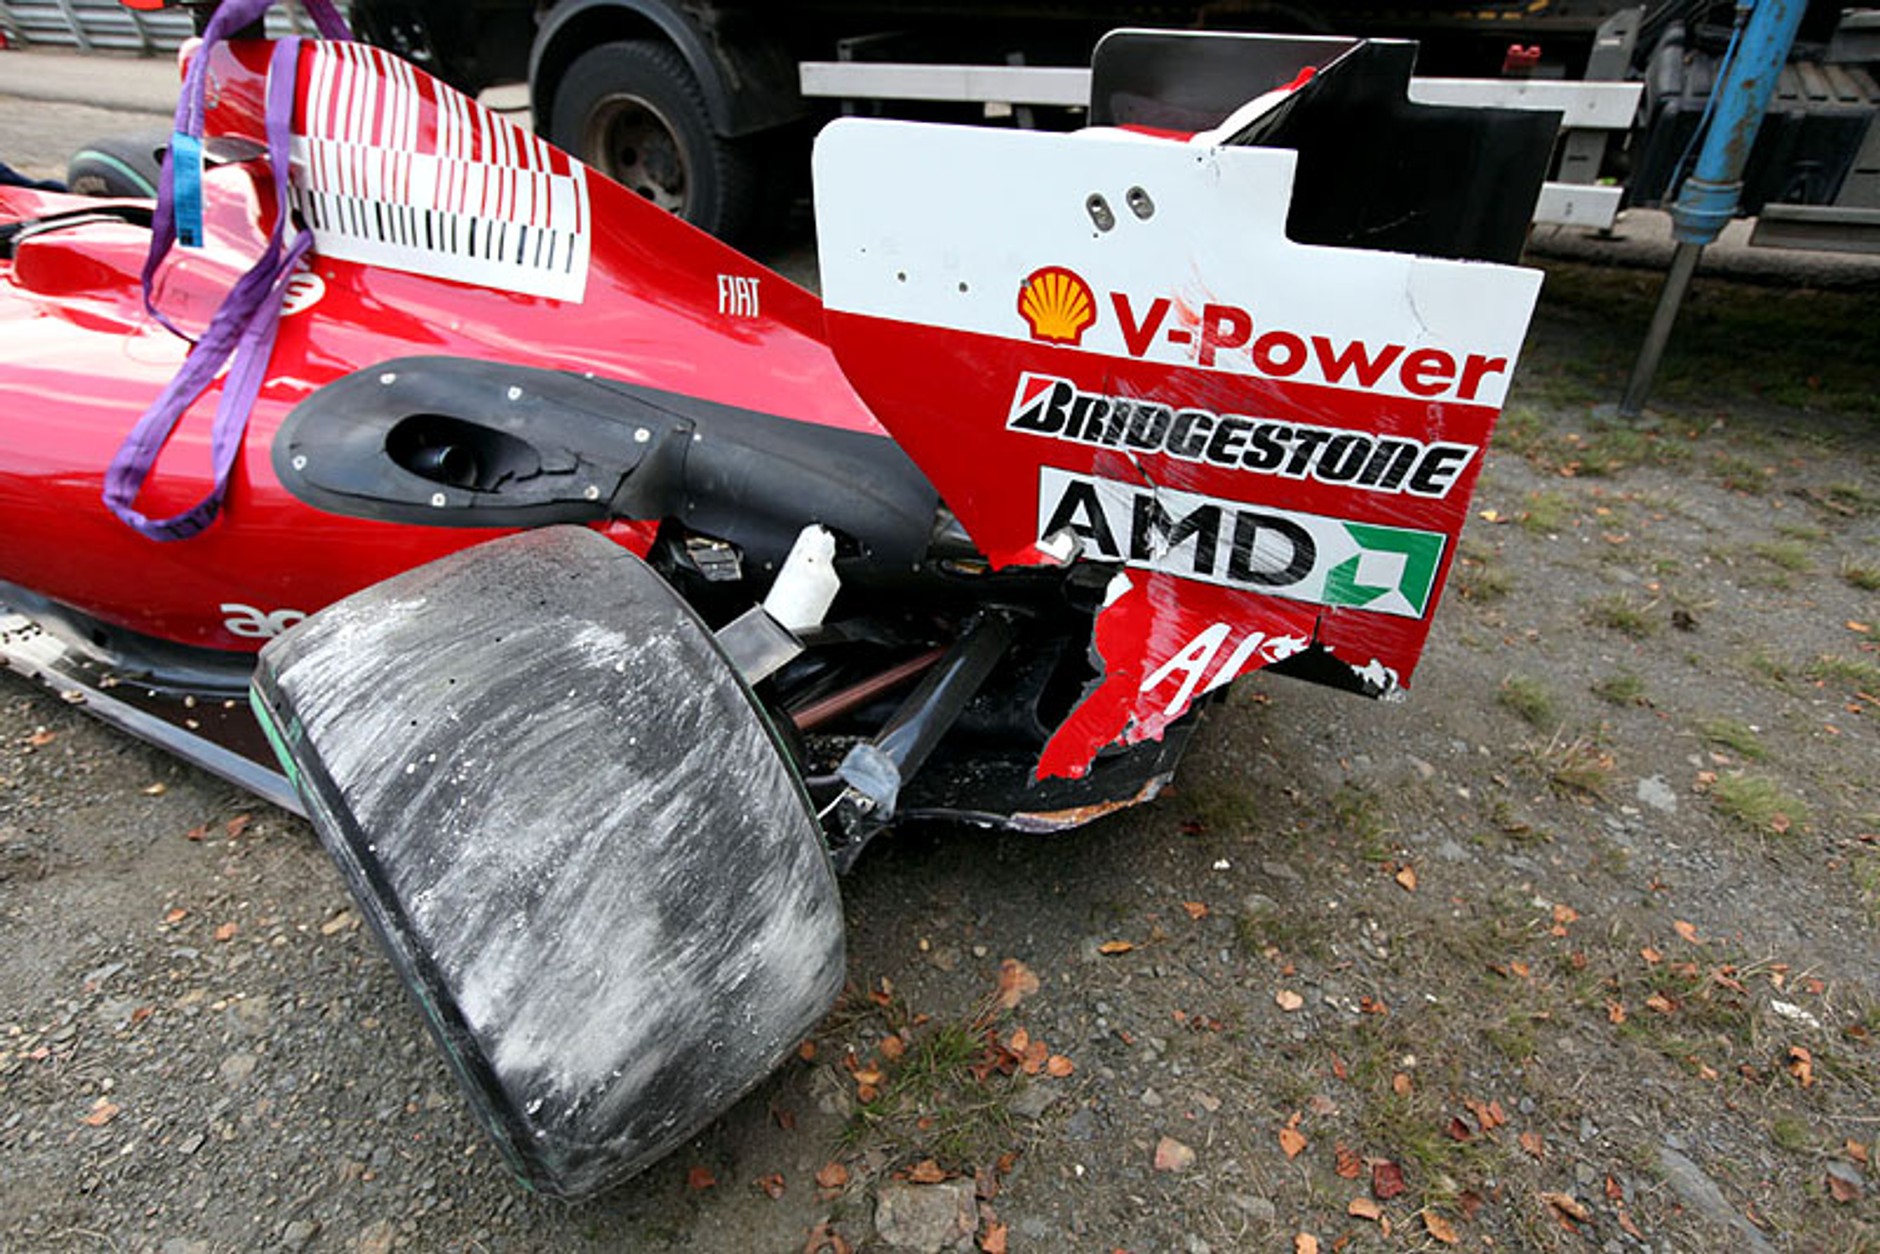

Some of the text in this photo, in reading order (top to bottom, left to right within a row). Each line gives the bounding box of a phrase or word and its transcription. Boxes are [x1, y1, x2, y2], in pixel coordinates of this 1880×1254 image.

[717, 274, 760, 318] FIAT
[1110, 292, 1507, 400] V-Power
[1010, 381, 1470, 495] BRIDGESTONE
[1041, 479, 1316, 586] AMD
